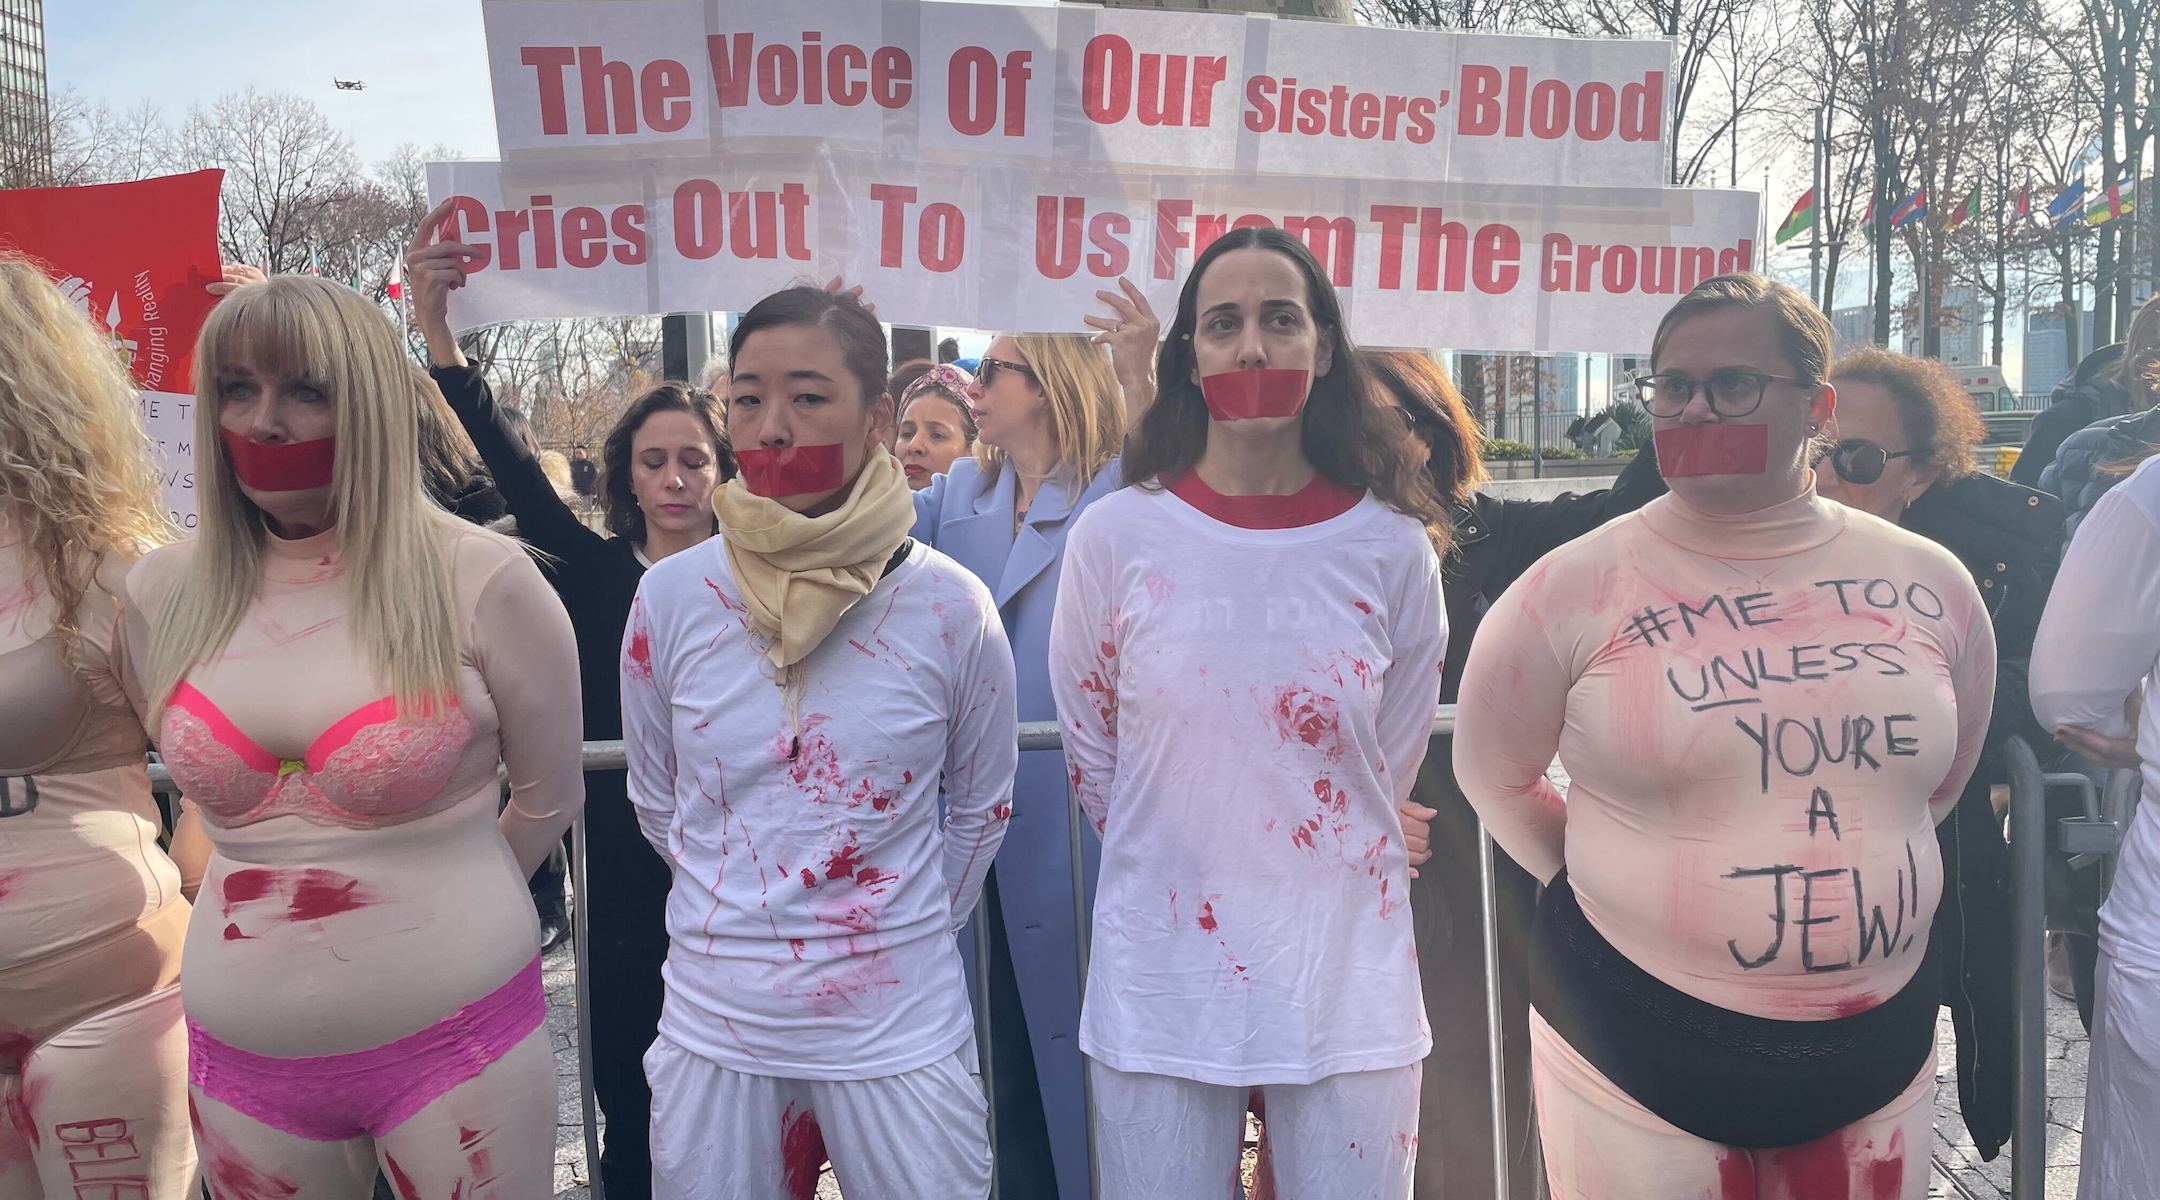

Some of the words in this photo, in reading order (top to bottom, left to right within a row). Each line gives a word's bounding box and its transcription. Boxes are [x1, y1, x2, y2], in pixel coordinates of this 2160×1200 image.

[520, 46, 693, 135] The
[707, 32, 913, 107] Voice
[948, 46, 1033, 137] Of
[1082, 34, 1228, 128] Our
[1457, 65, 1666, 142] Blood
[438, 195, 648, 275] Cries
[672, 179, 812, 261] Out
[870, 183, 965, 273] To
[1034, 195, 1132, 279] Us
[1370, 204, 1522, 295] The
[1541, 232, 1753, 295] Ground
[134, 269, 161, 322] Reality
[1623, 591, 1783, 647] #ME
[1814, 578, 1943, 620] TOO
[1667, 642, 1909, 703] UNLESS
[1735, 712, 1919, 794] YOURE
[1805, 786, 1840, 841] A
[1720, 838, 1918, 971] JEW!
